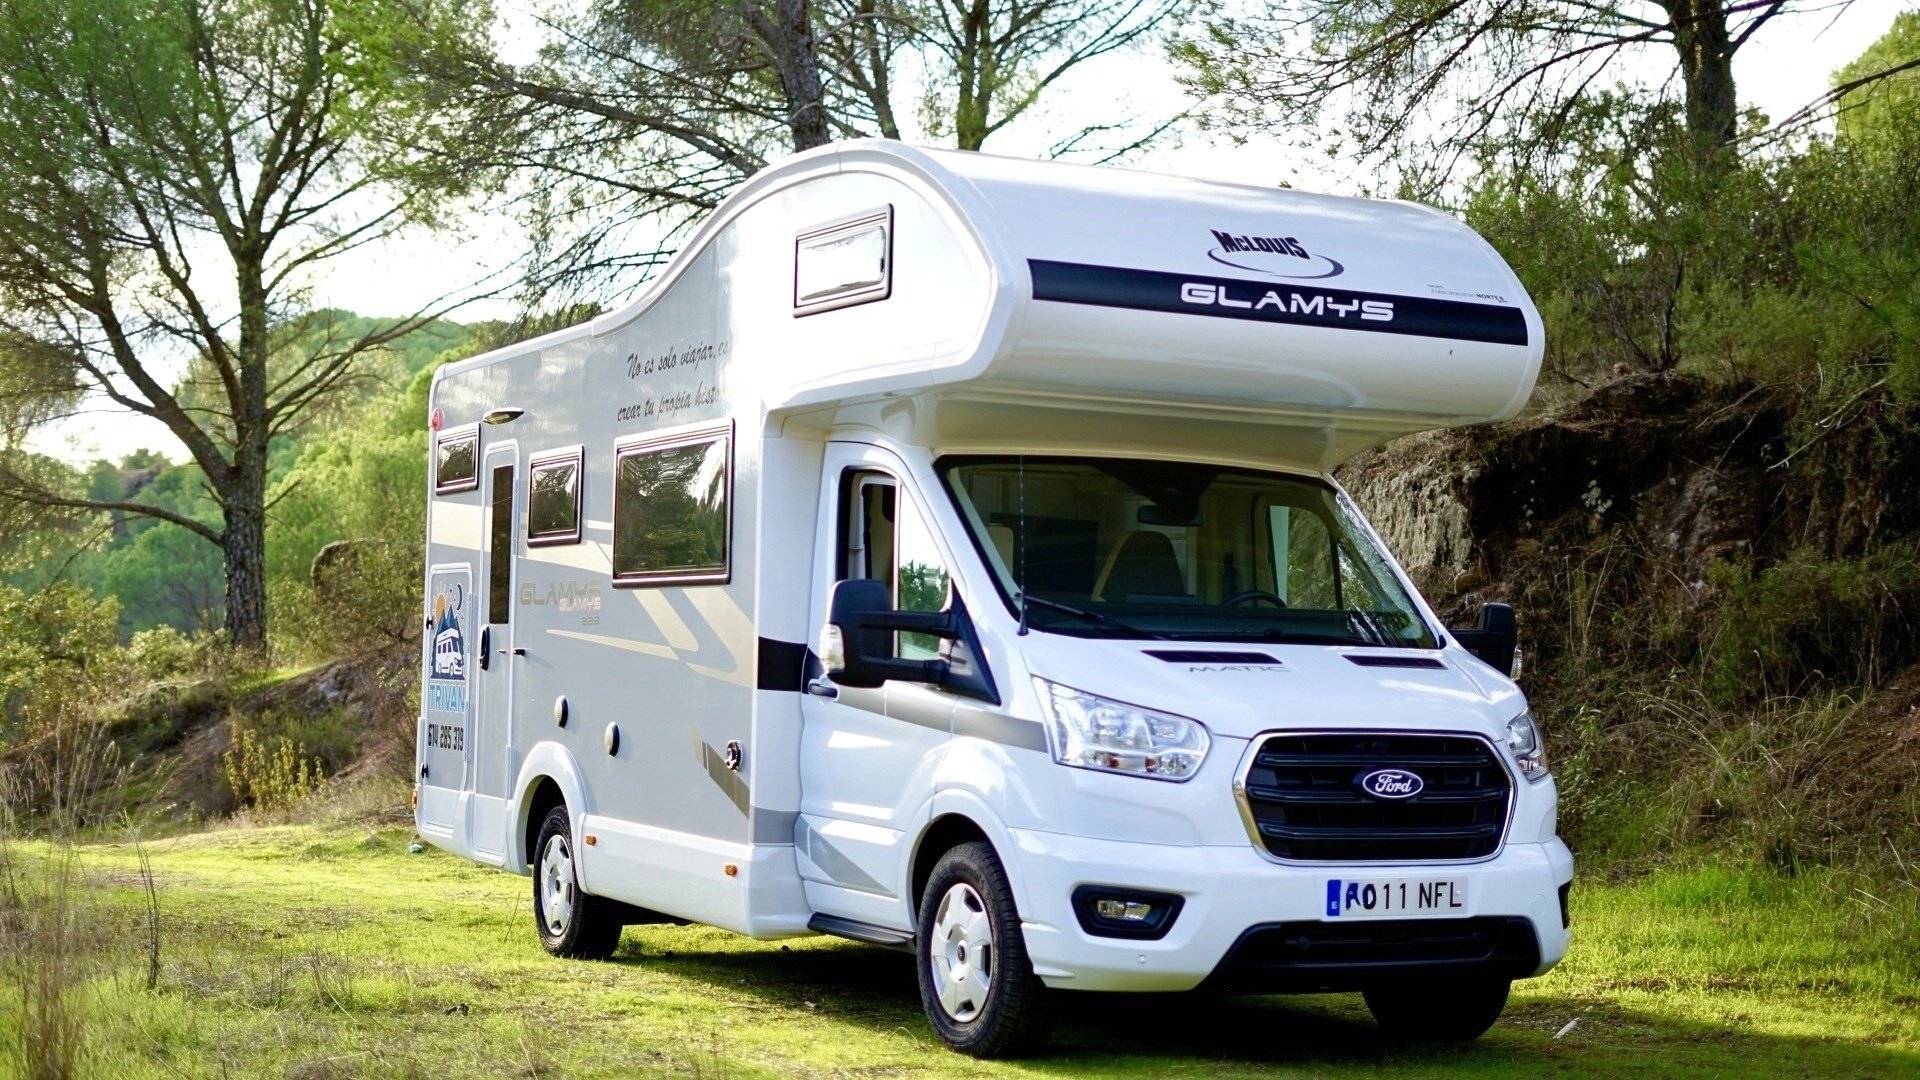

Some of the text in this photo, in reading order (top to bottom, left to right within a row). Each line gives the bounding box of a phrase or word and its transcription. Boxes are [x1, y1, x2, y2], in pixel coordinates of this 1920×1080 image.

[1181, 282, 1394, 322] GLAMYS
[627, 352, 641, 379] No
[644, 357, 655, 375] es
[657, 346, 677, 371] solo
[617, 404, 641, 422] crear
[645, 397, 655, 416] tu
[657, 391, 691, 421] propia
[429, 684, 465, 712] TRIVAN
[428, 724, 464, 751] 614 285 319
[1375, 774, 1412, 792] Ford
[1419, 882, 1462, 908] NFL
